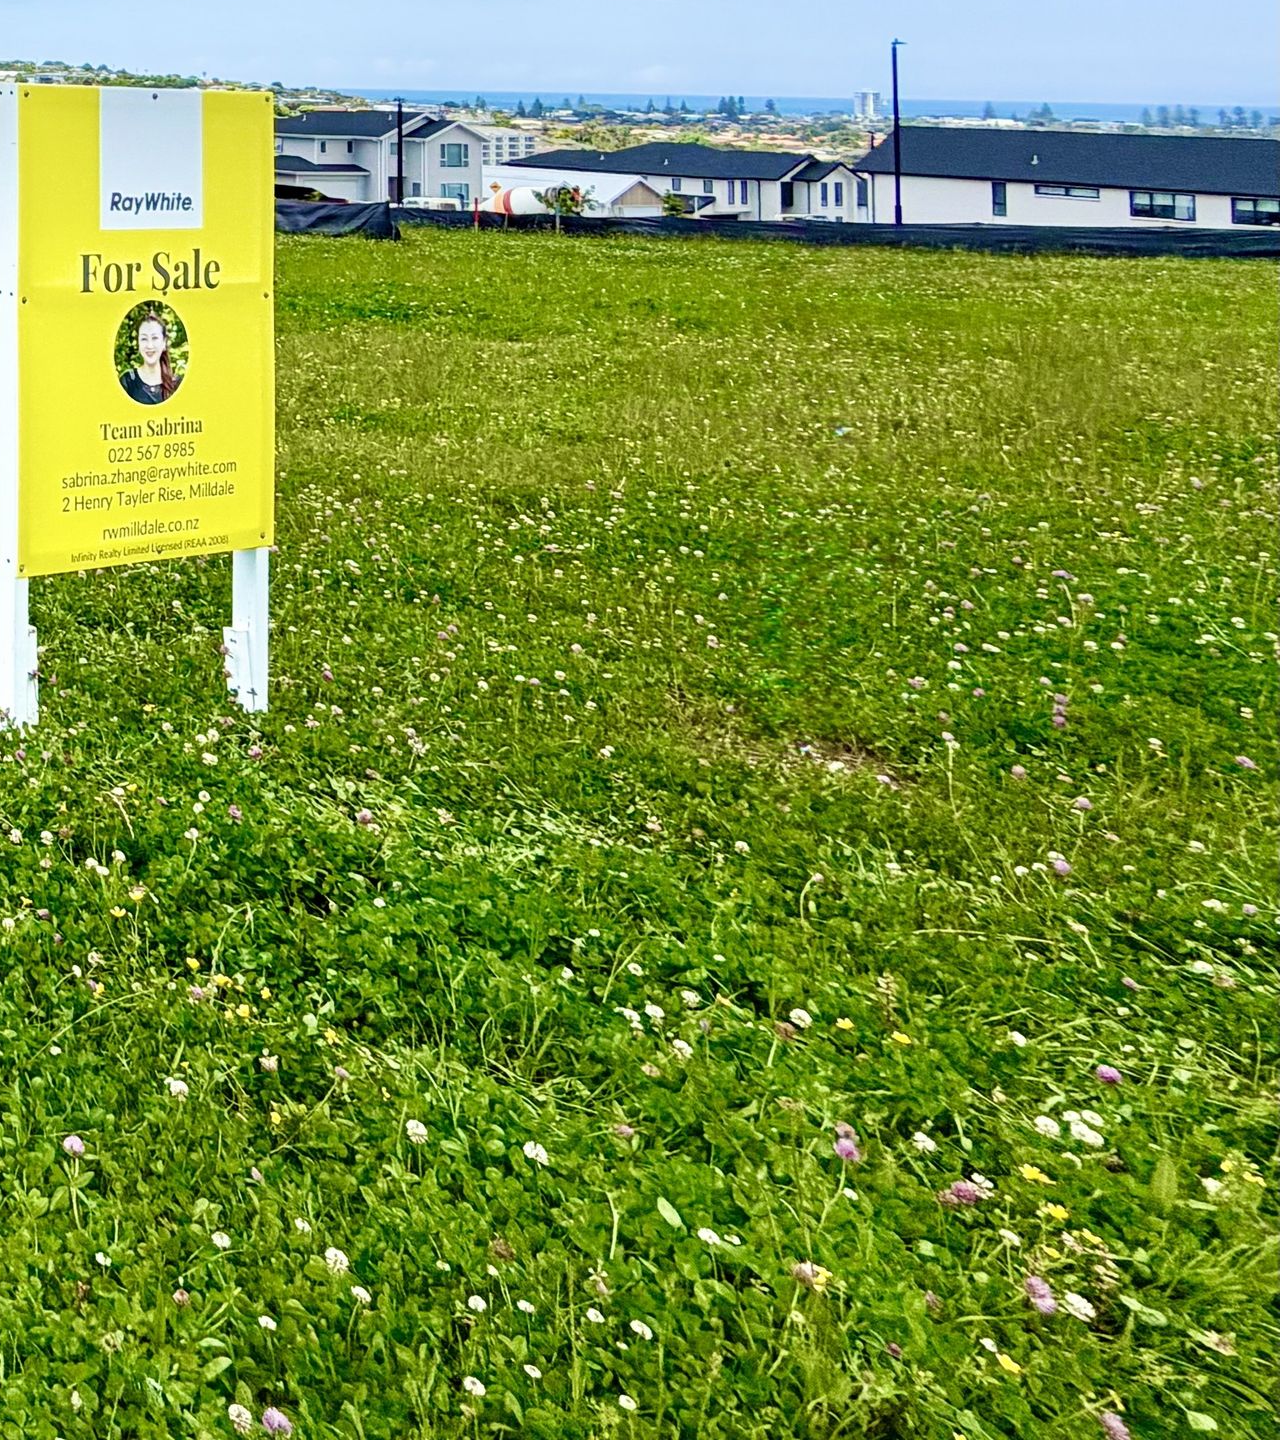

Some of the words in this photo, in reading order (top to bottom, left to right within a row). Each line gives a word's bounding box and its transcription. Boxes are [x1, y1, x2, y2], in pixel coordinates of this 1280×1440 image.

[80, 253, 142, 293] For
[152, 248, 220, 291] Sale
[100, 422, 142, 441] Team
[146, 416, 203, 437] Sabrina
[108, 447, 133, 463] 022
[137, 444, 161, 460] 567
[164, 441, 195, 458] 8985
[62, 461, 237, 489] sabrina.zhang@raywhite.com
[62, 497, 71, 512] 2
[74, 495, 113, 511] Henry
[116, 490, 155, 509] Tayler
[158, 487, 186, 502] Rise,
[189, 480, 235, 498] Milldale
[102, 517, 200, 540] rwmilldale.co.nz
[70, 552, 97, 563] Infinity
[99, 548, 122, 560] Realty
[123, 544, 150, 557] Limited
